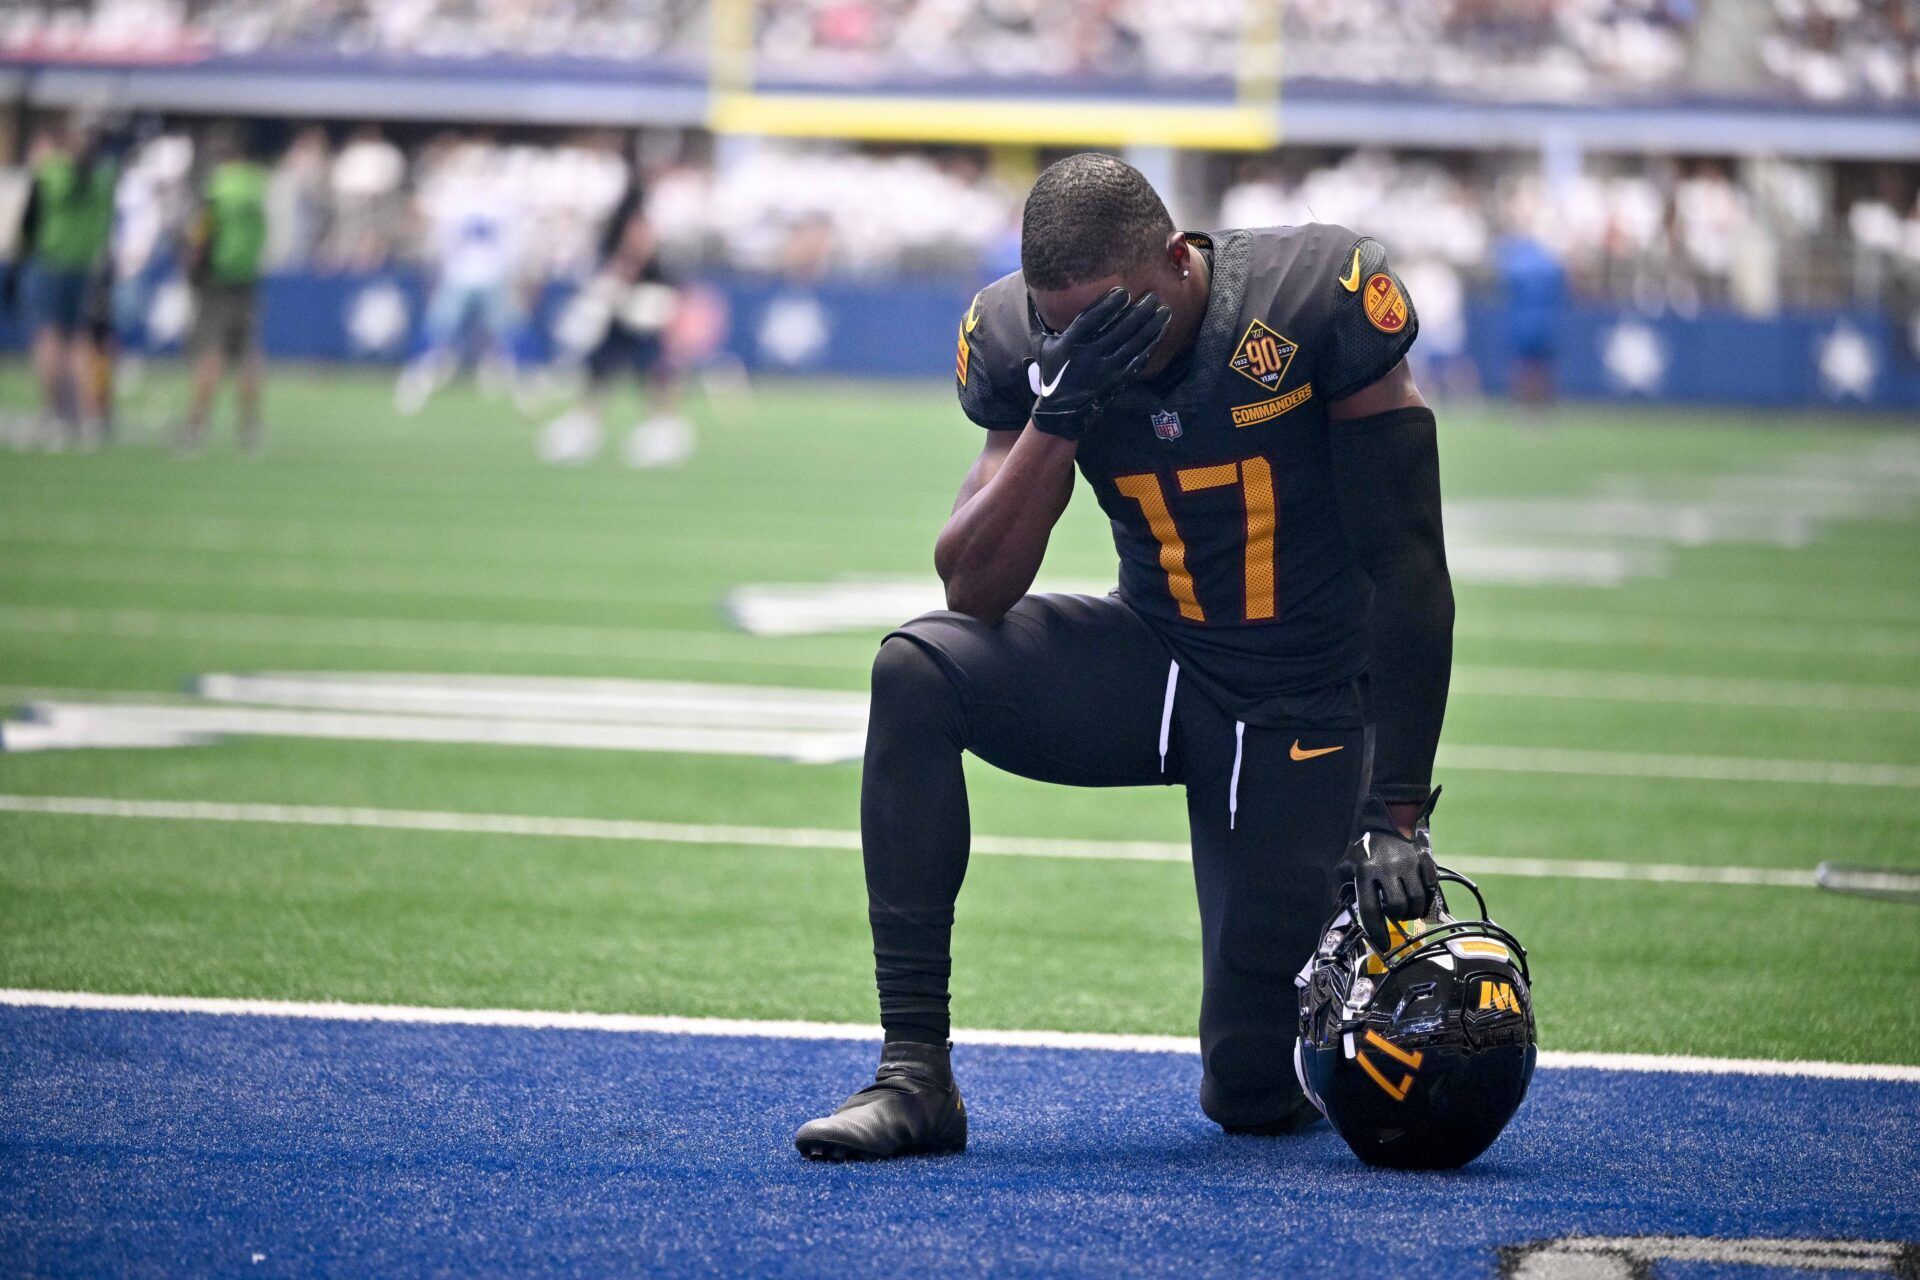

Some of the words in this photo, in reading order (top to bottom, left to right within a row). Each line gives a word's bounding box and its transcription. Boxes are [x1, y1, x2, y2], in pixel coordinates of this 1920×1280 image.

[1370, 294, 1379, 306] 19
[1245, 336, 1282, 376] 90
[1278, 345, 1294, 355] 2022
[1234, 358, 1248, 367] 1932
[1261, 372, 1279, 382] YEARS
[1232, 385, 1312, 424] COMMANDERS
[1156, 423, 1180, 437] NFL
[1112, 455, 1276, 622] 17
[1356, 1030, 1424, 1101] 17
